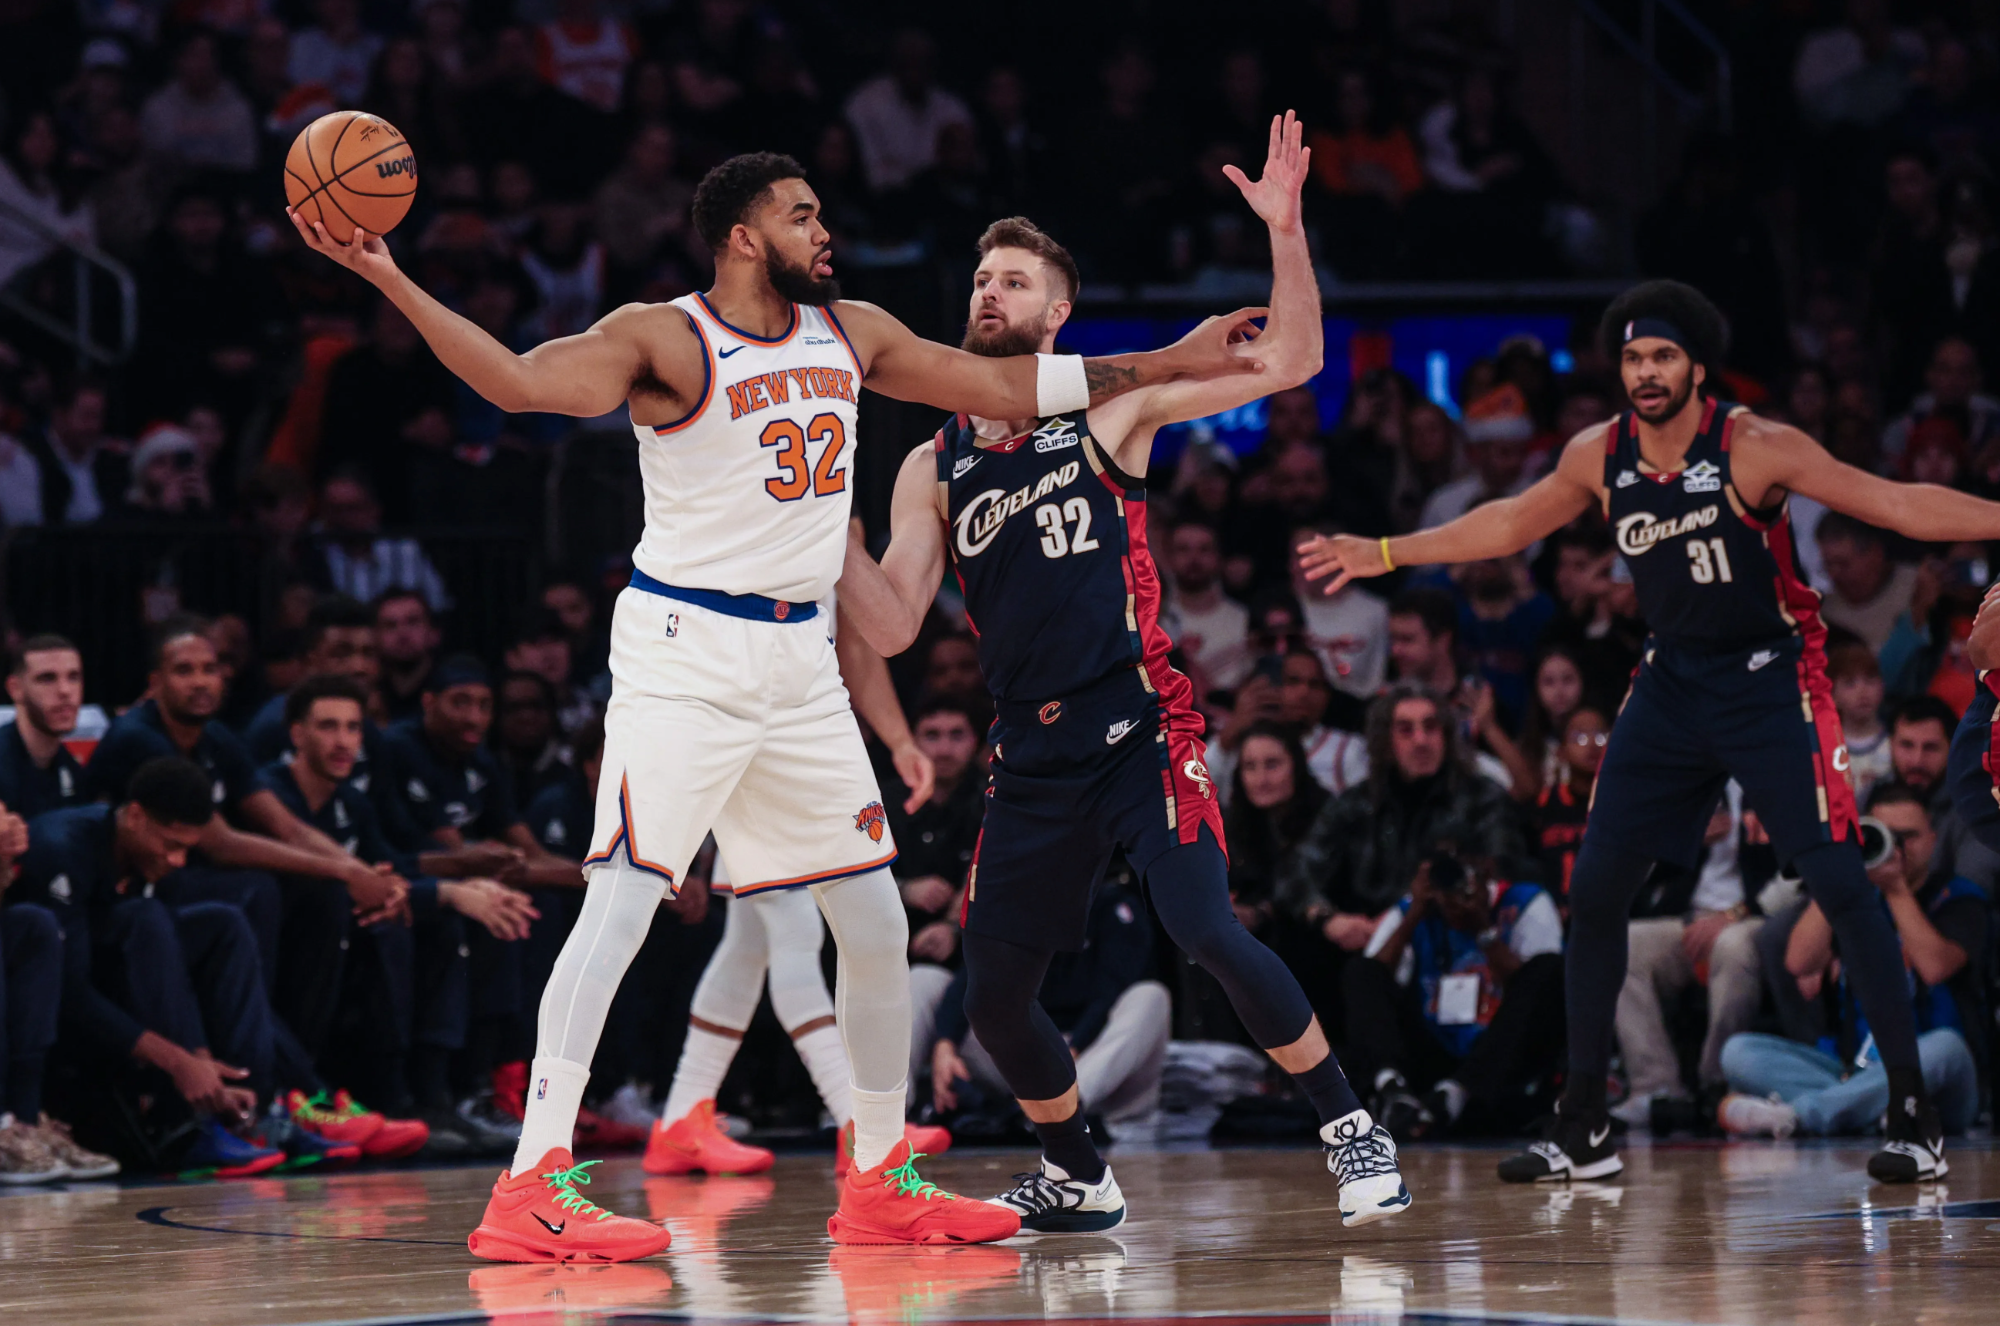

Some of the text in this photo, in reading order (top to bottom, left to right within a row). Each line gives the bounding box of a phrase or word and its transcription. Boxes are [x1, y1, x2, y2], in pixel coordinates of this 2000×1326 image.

[725, 366, 858, 421] NEW YORK
[1036, 435, 1077, 451] CLIFFS
[759, 411, 846, 503] 32
[954, 455, 975, 472] NIKE
[1685, 480, 1720, 492] CLIFFS
[1035, 496, 1100, 559] 32
[1686, 537, 1733, 584] 31
[1038, 701, 1062, 725] C
[1109, 719, 1131, 737] NIKE
